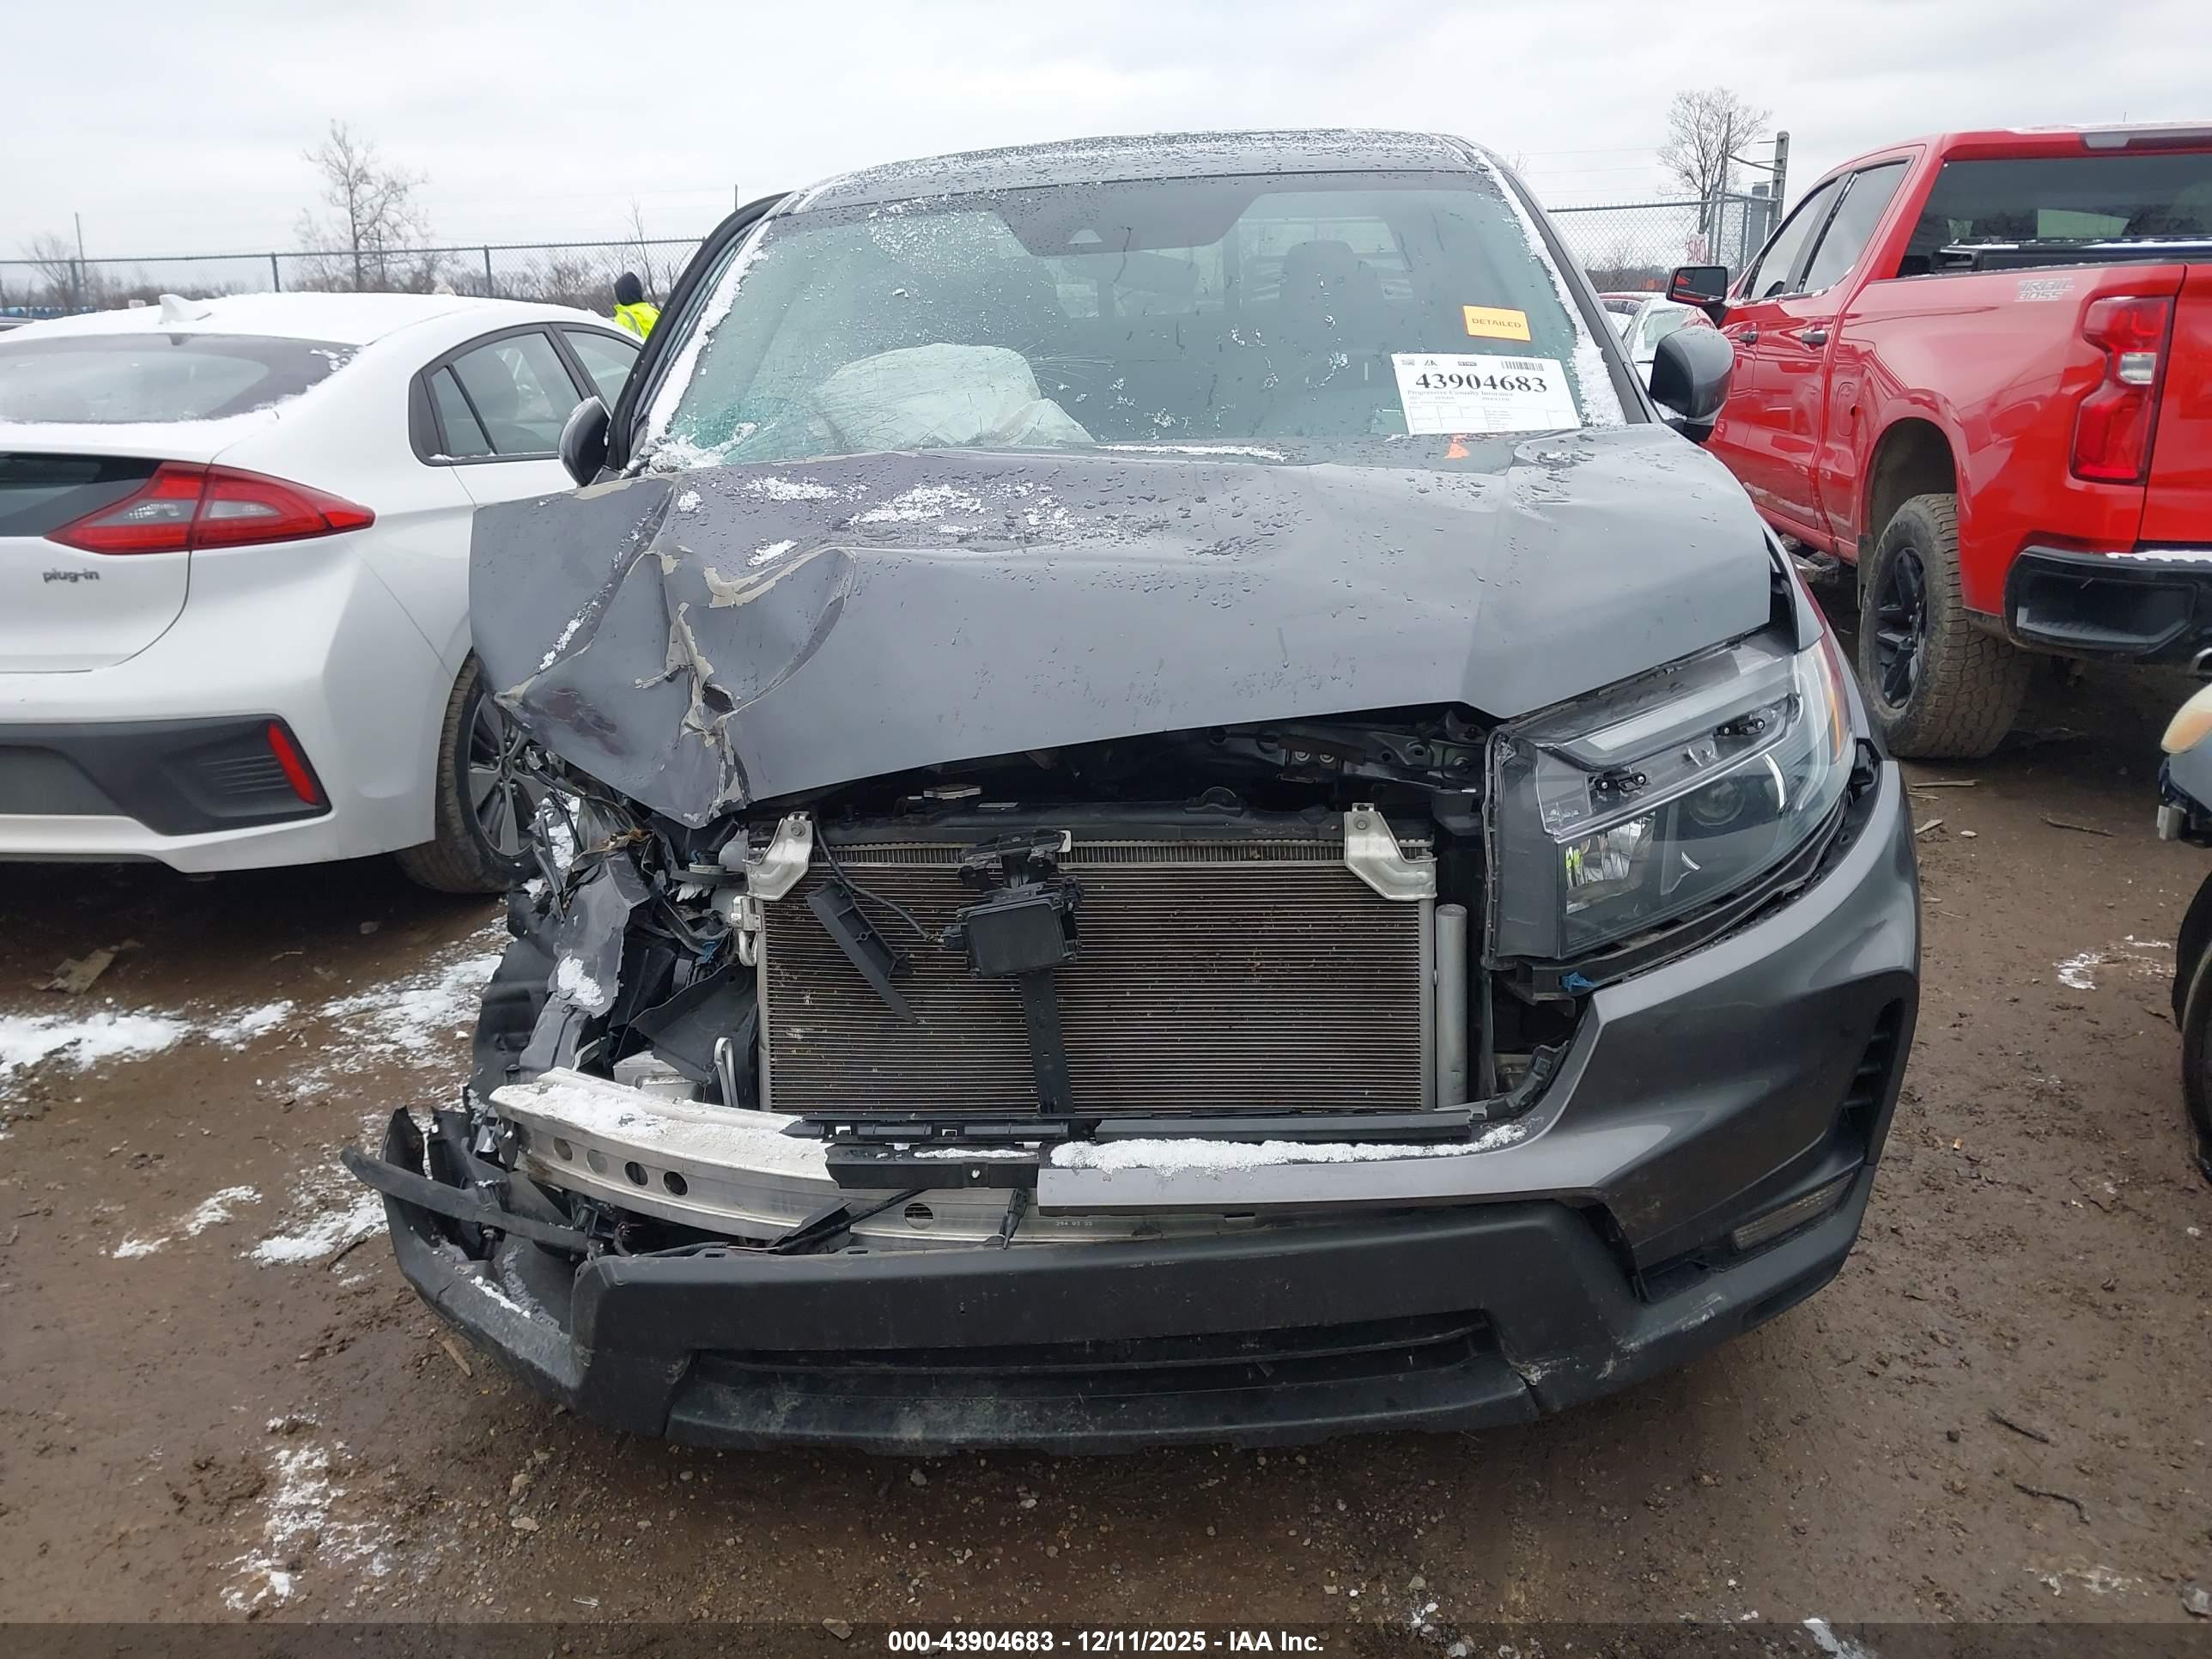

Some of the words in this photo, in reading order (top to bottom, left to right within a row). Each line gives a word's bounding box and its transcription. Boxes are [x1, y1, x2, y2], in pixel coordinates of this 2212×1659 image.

[2018, 277, 2075, 291] TRAIL
[2015, 290, 2063, 301] BOSS
[1472, 318, 1522, 328] DETAILED
[1416, 373, 1547, 393] 43904683
[42, 568, 100, 583] plug-in
